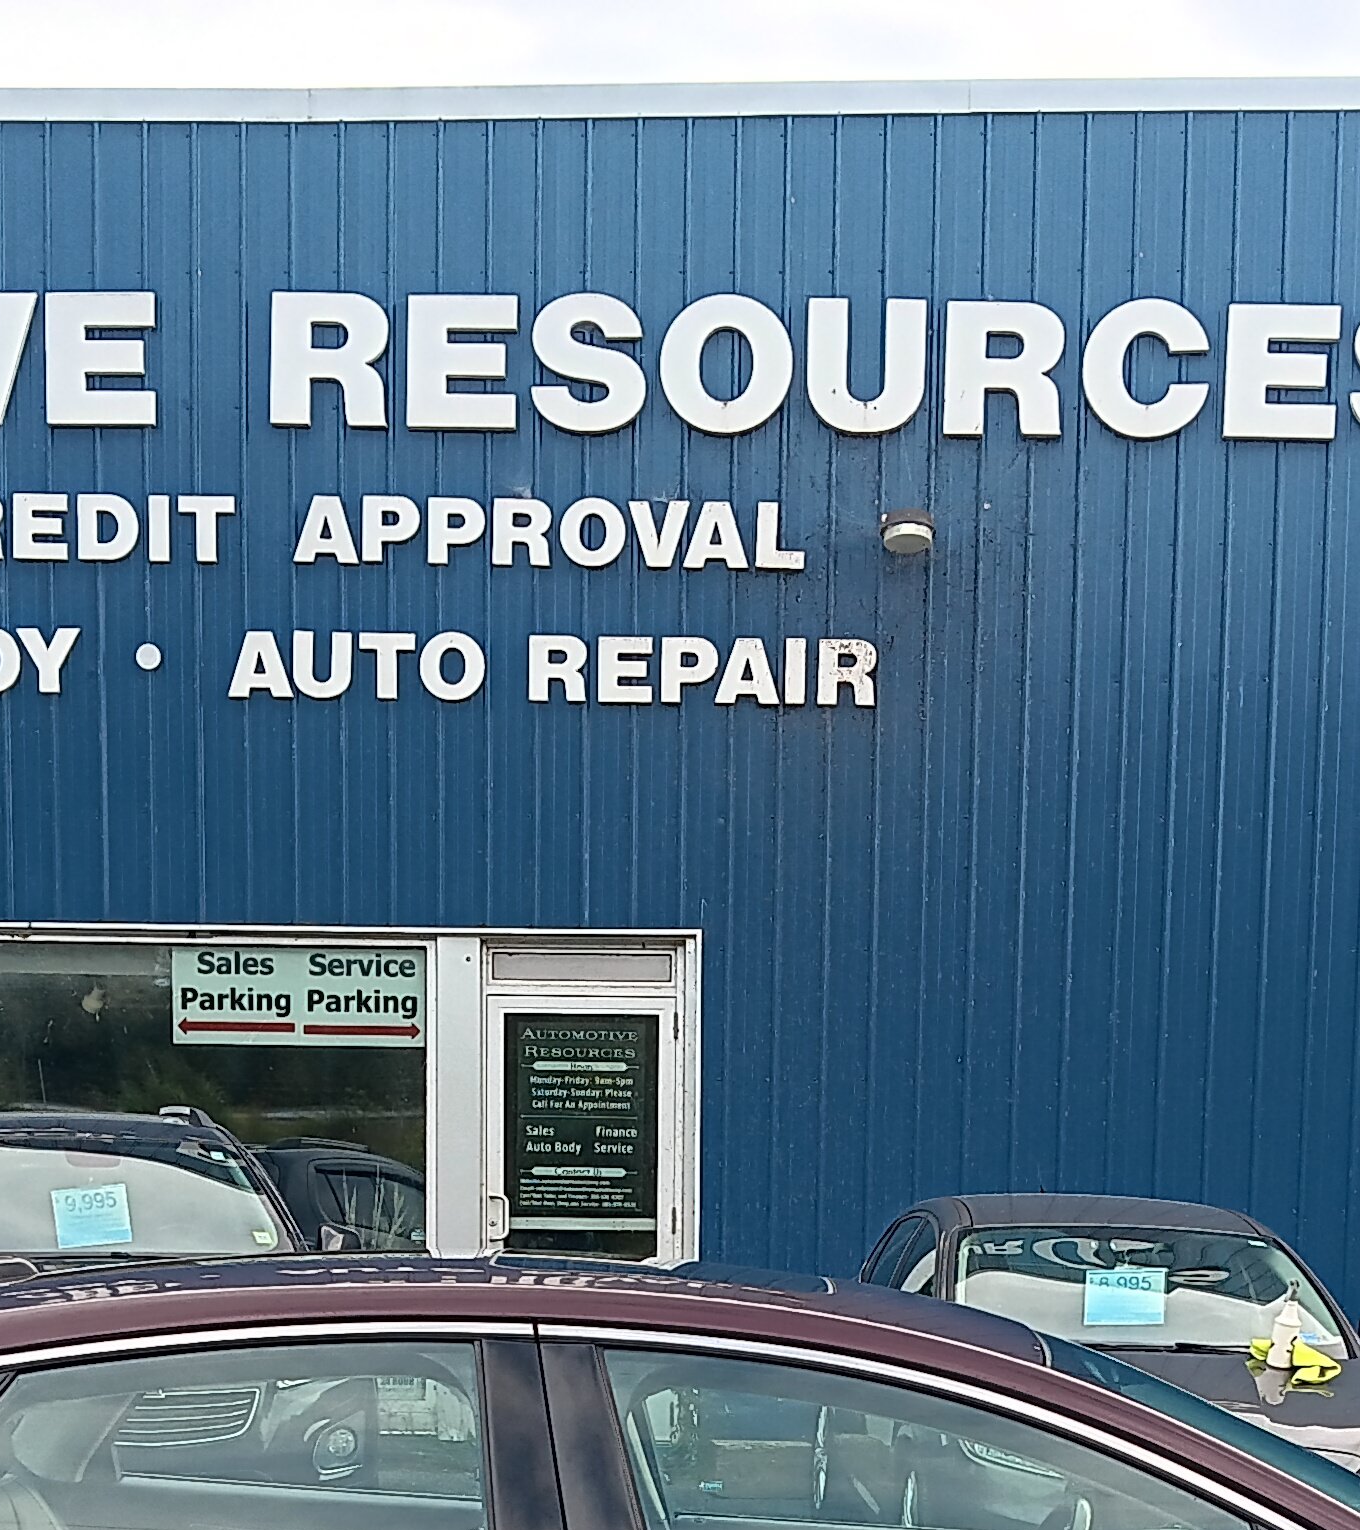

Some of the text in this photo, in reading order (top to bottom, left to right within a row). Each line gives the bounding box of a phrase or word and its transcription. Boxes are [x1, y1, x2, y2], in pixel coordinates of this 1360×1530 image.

[293, 495, 806, 571] APPROVAL
[228, 630, 487, 702] AUTO
[528, 634, 878, 707] REPAIR
[197, 950, 275, 976] Sales
[308, 953, 417, 978] Service
[180, 987, 292, 1018] Parking
[307, 989, 418, 1020] Parking
[520, 1027, 638, 1042] AUTOMOTIVE
[524, 1045, 636, 1059] RESOURCES
[605, 1088, 633, 1098] Please
[578, 1100, 631, 1111] Appointment
[525, 1125, 555, 1136] Sales
[595, 1125, 638, 1138] Finance
[525, 1140, 582, 1156] Auto Body
[593, 1142, 634, 1154] Service
[1099, 1276, 1152, 1291] 8995
